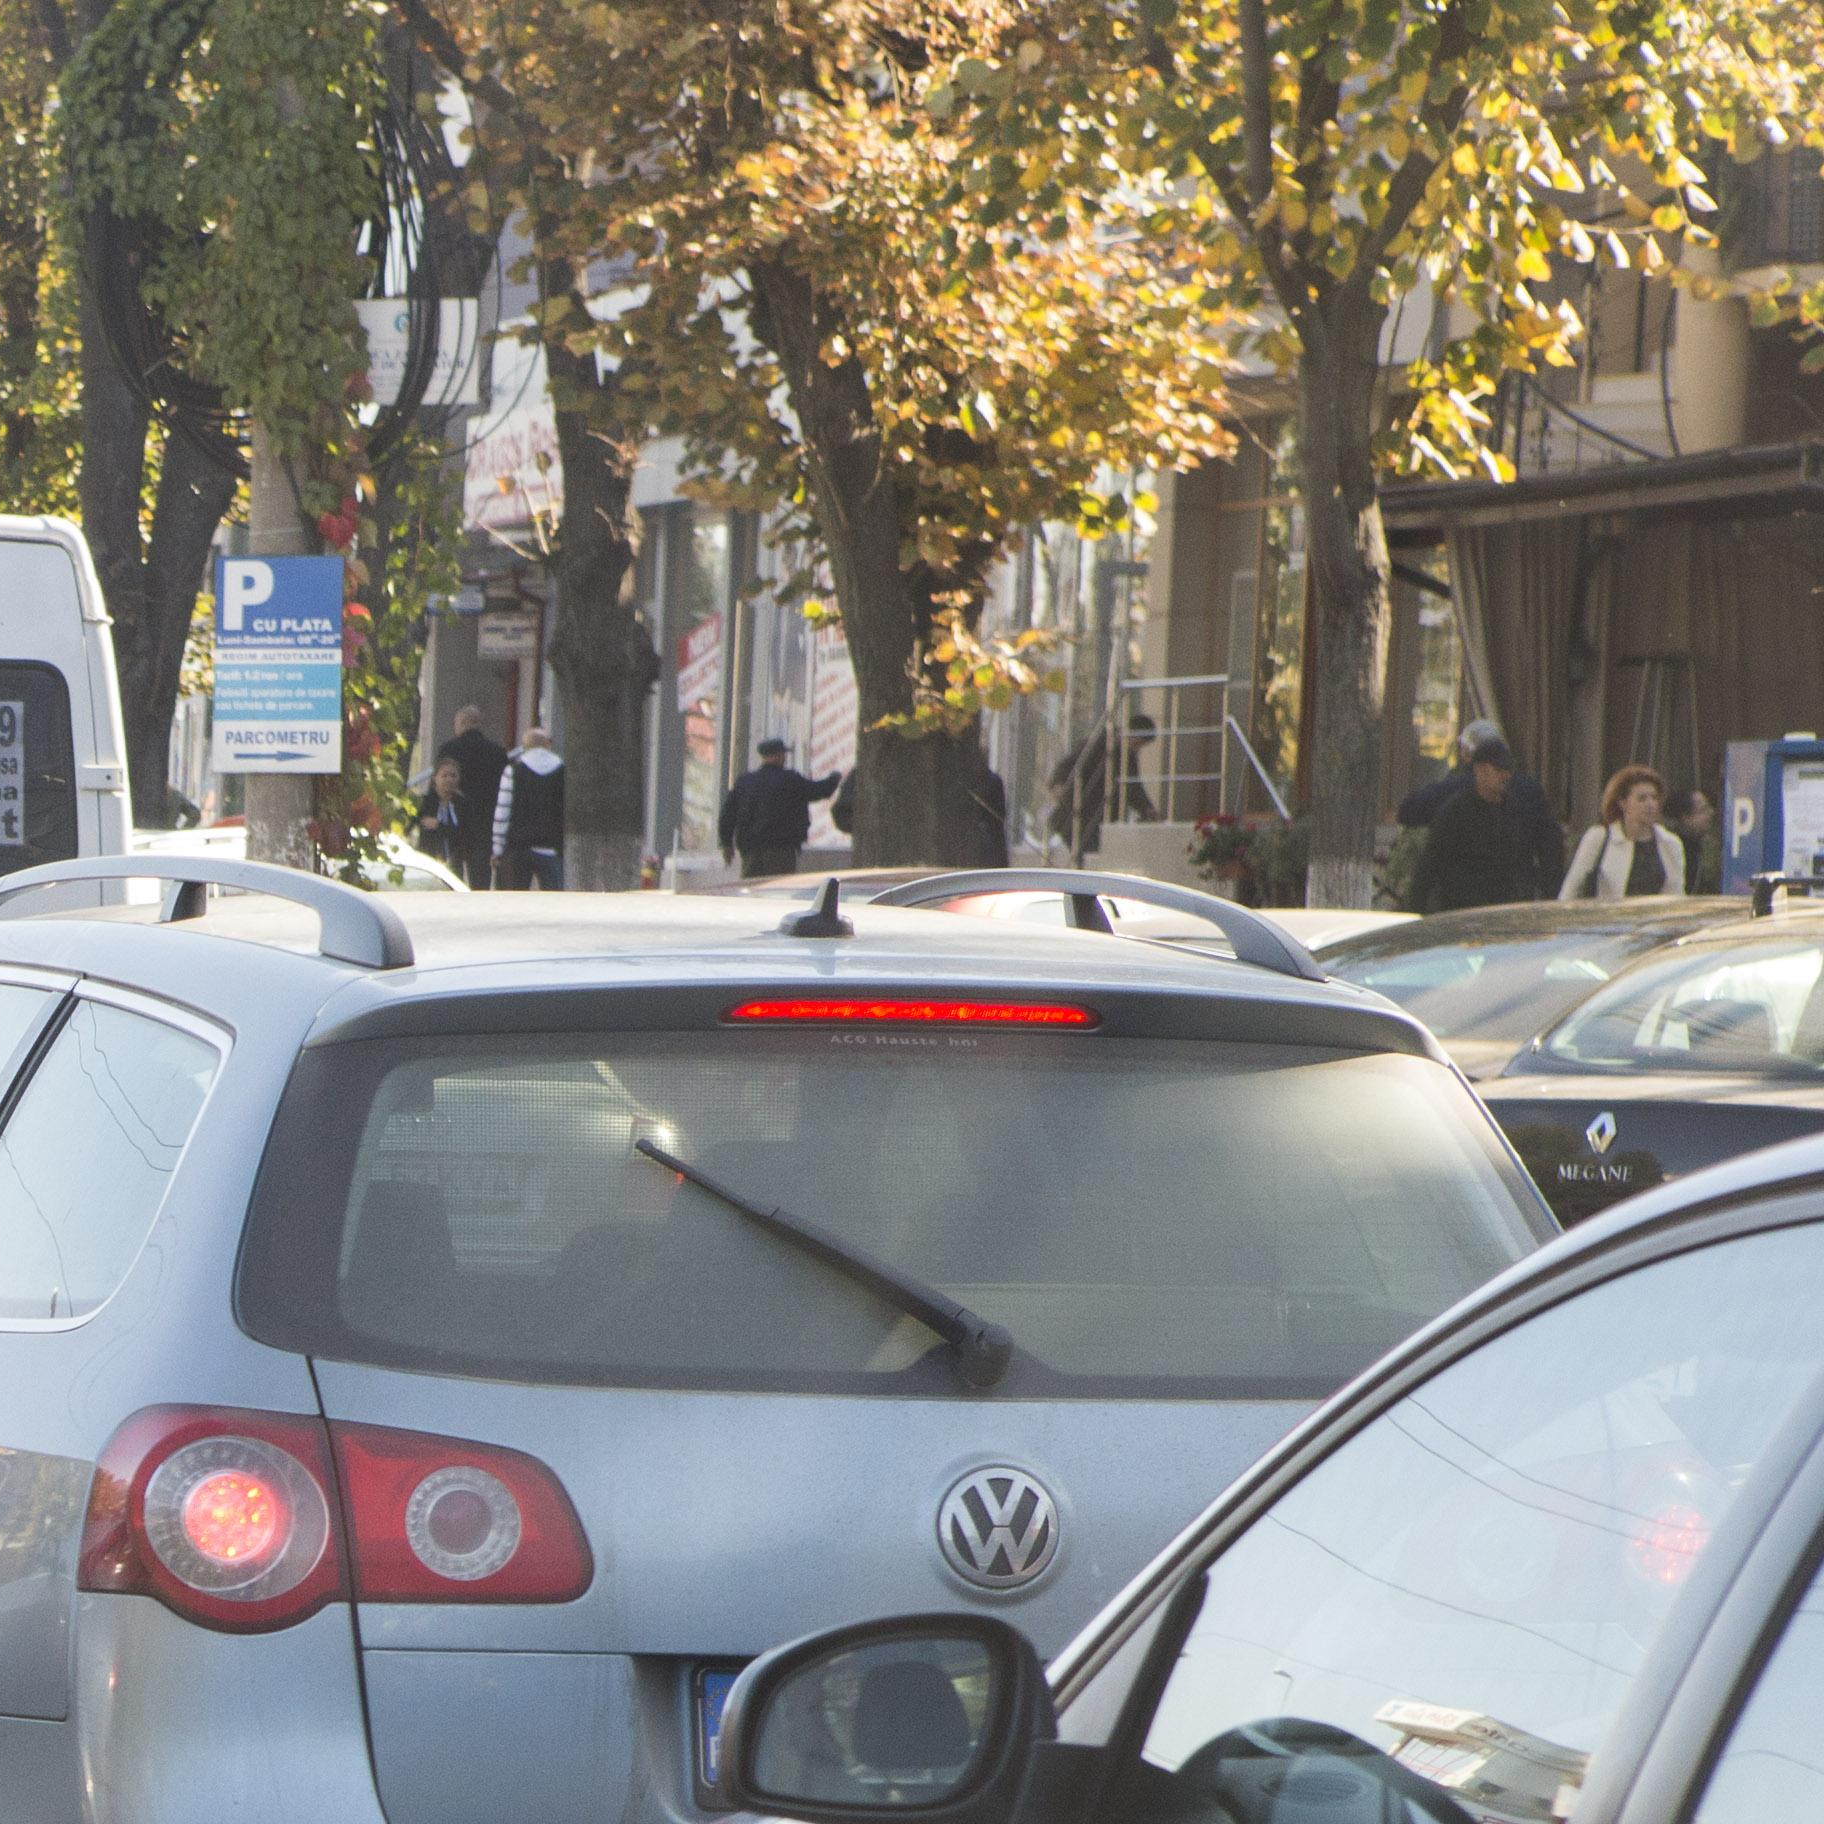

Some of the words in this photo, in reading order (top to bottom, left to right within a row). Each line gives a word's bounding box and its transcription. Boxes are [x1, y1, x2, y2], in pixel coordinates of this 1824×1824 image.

[223, 560, 274, 631] P
[252, 618, 277, 632] CU
[280, 618, 333, 632] PLATA
[225, 731, 330, 744] PARCOMETRU
[1731, 798, 1754, 858] P
[1557, 1164, 1633, 1181] MEGANE
